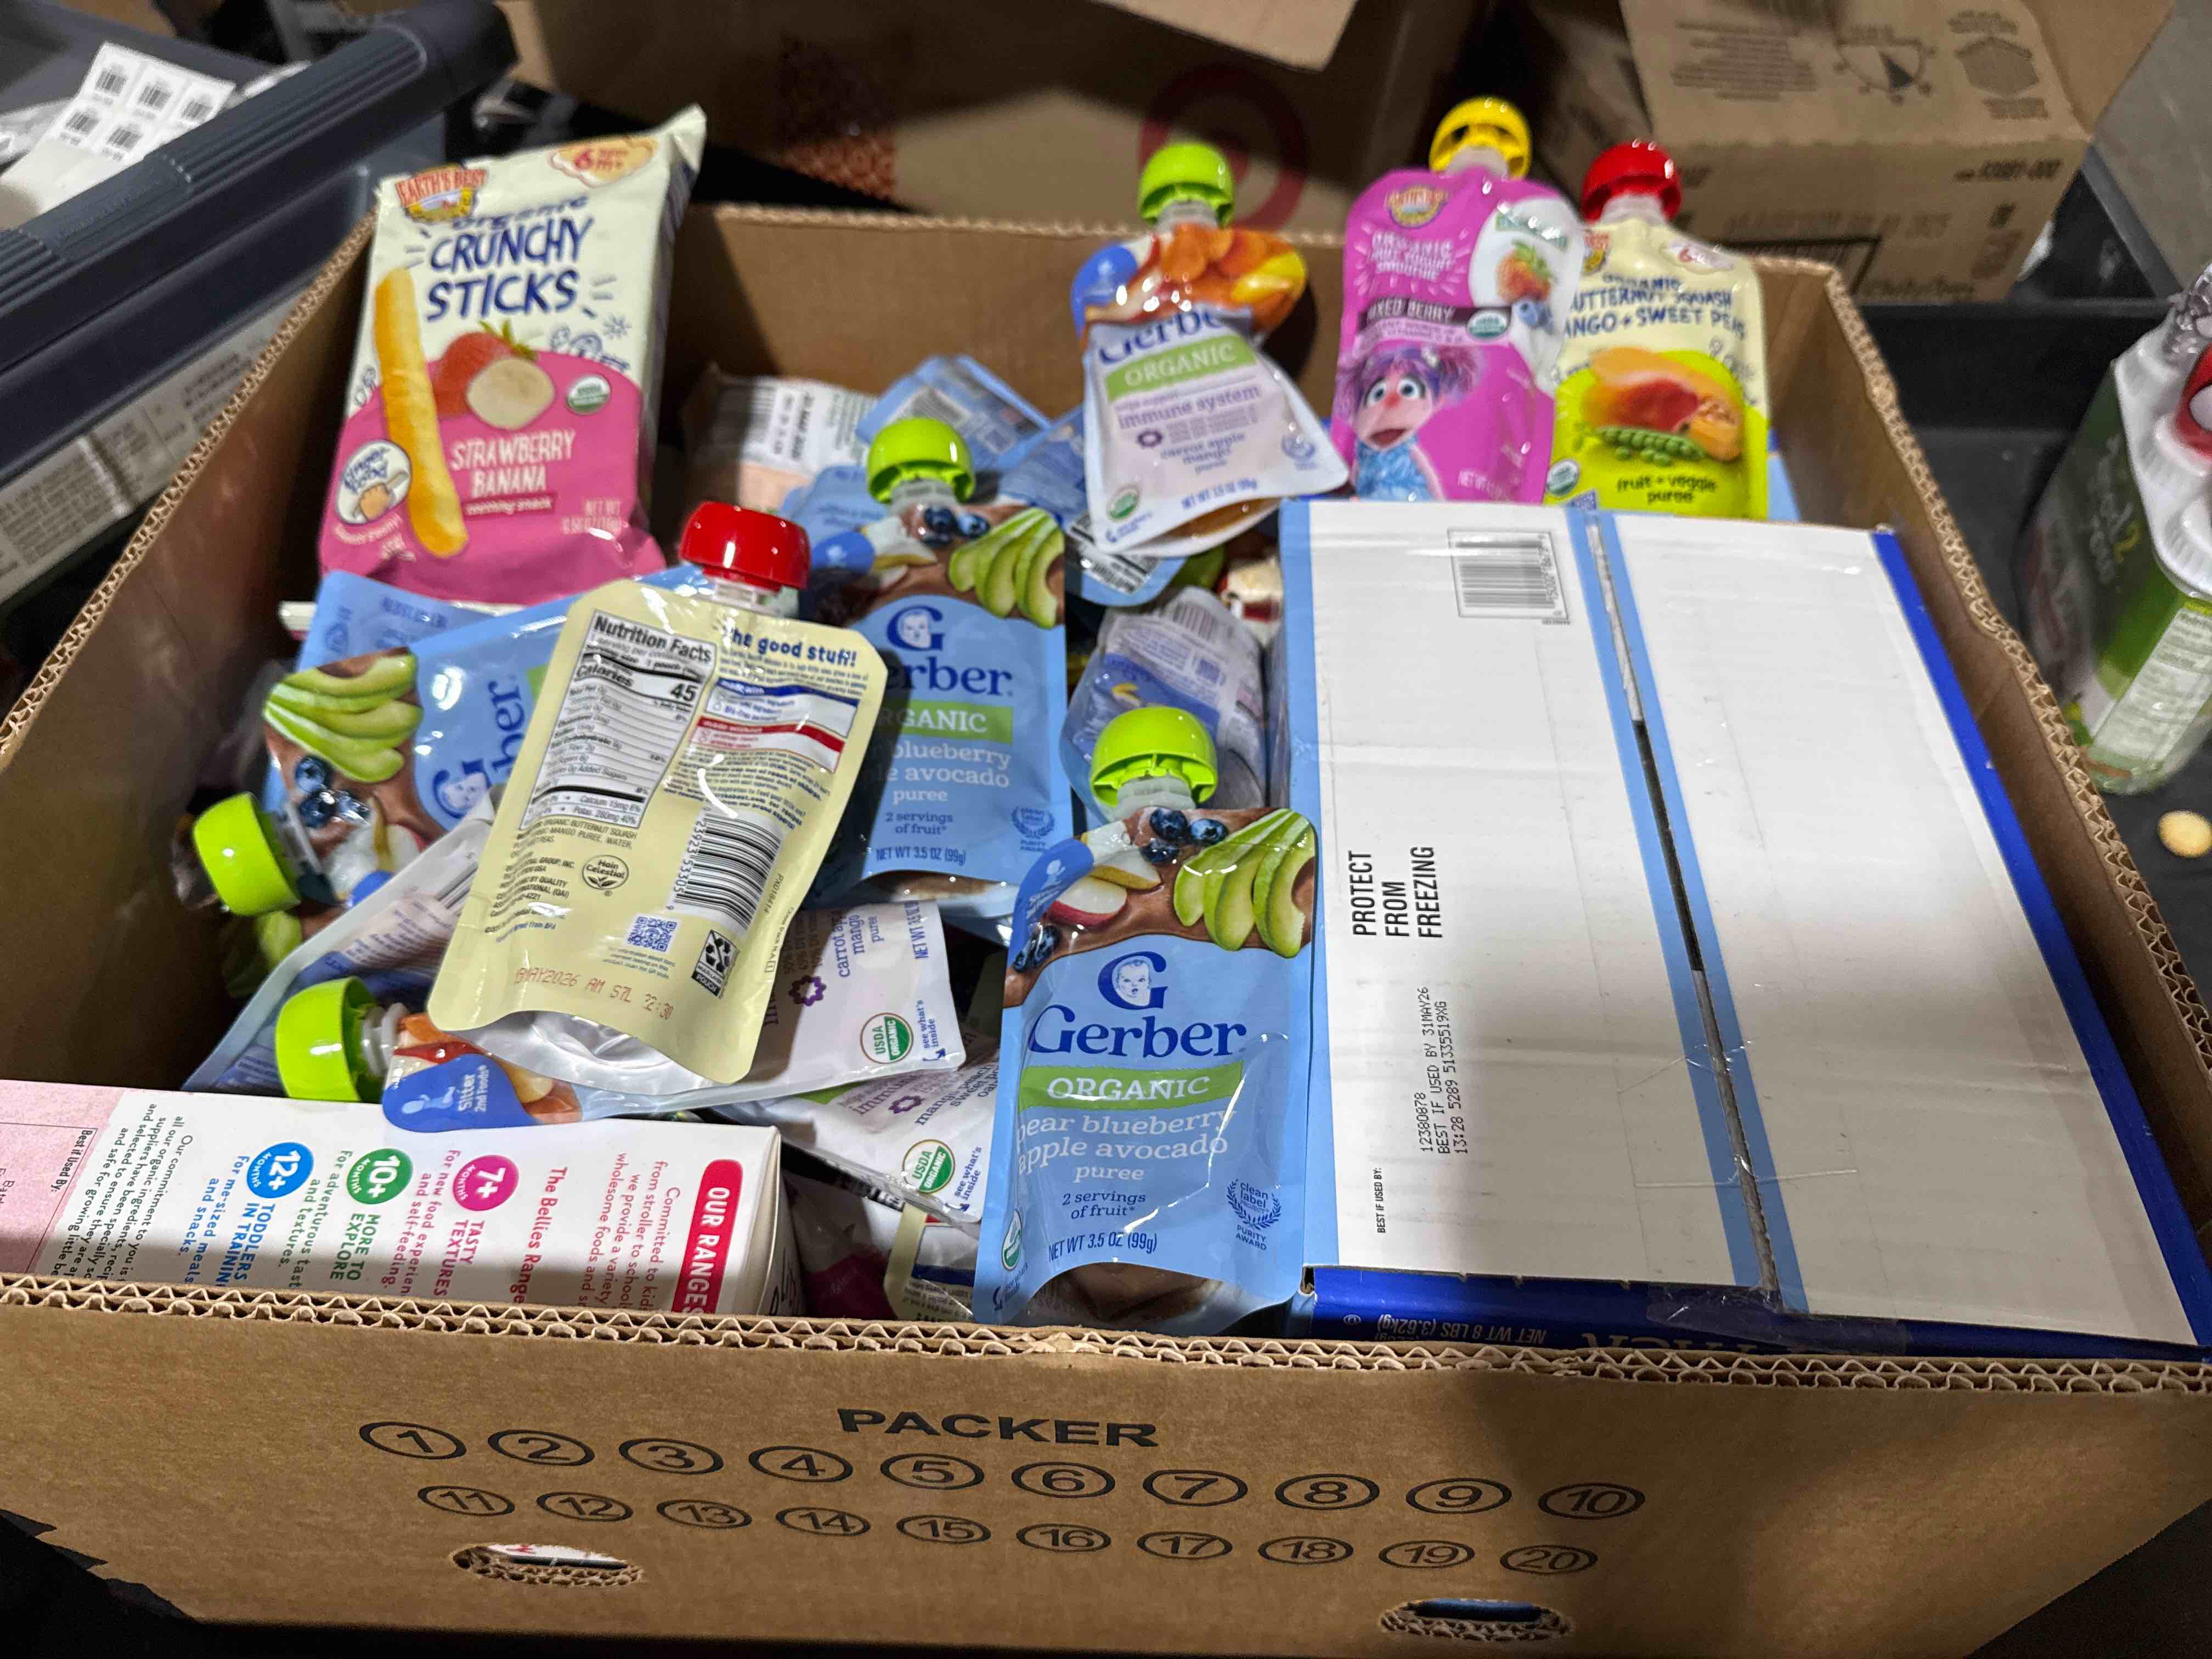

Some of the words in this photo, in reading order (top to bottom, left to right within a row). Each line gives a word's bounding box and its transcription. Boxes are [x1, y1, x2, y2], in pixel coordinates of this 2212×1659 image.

[430, 218, 594, 273] CRUNCHY
[426, 269, 579, 323] STICKS
[1564, 310, 1617, 338] ANGO
[1635, 305, 1702, 327] SWEET
[1124, 341, 1238, 386] ORGANIC
[1118, 402, 1193, 429] immune
[1195, 387, 1260, 411] system
[451, 431, 574, 470] STRAWBERRY
[472, 466, 546, 498] BANANA
[1647, 488, 1694, 505] puree
[595, 615, 667, 649] Nutrition
[670, 639, 712, 664] Facts
[758, 637, 803, 658] good
[807, 645, 857, 667] stuff!
[670, 684, 697, 702] 45
[904, 766, 1010, 788] avocado
[893, 789, 949, 806] puree
[896, 812, 953, 825] servings
[598, 859, 619, 870] Hain
[894, 847, 912, 859] WT
[585, 864, 625, 879] Celestial
[1348, 850, 1377, 935] PROTECT
[1410, 847, 1443, 939] FREEZING
[1381, 881, 1409, 937] FROM
[849, 914, 865, 955] mango
[868, 915, 884, 943] puree
[833, 933, 850, 978] carrot
[917, 1000, 929, 1034] what's
[1417, 987, 1435, 1036] 31MAY26
[872, 1025, 886, 1054] USDA
[887, 1019, 901, 1056] ORGANIC
[928, 1018, 939, 1047] inside
[1028, 1004, 1247, 1058] Gerber
[1424, 1043, 1437, 1057] BY
[458, 1074, 475, 1113] Sitter
[1047, 1076, 1210, 1101] ORGANIC
[1427, 1064, 1442, 1094] USED
[1444, 1080, 1462, 1109] 5289
[1082, 1109, 1238, 1137] blueberry
[1431, 1101, 1445, 1114] IF
[74, 1130, 93, 1148] Best
[121, 1124, 146, 1165] selected
[139, 1116, 167, 1159] suppliers
[175, 1135, 194, 1156] Our
[1434, 1123, 1451, 1154] BEST
[1450, 1116, 1468, 1154] 13:28
[59, 1156, 78, 1177] Used
[103, 1147, 118, 1168] safe
[141, 1149, 167, 1192] organic
[268, 1150, 301, 1192] 12+
[442, 1149, 461, 1167] For
[912, 1150, 932, 1180] USDA
[924, 1151, 948, 1189] ORGANIC
[962, 1146, 983, 1181] what's
[1018, 1136, 1088, 1176] apple
[1094, 1136, 1229, 1160] avocado
[131, 1163, 146, 1187] have
[201, 1177, 219, 1203] and
[367, 1155, 401, 1199] 10+
[416, 1172, 431, 1197] and
[433, 1171, 449, 1195] new
[545, 1166, 568, 1193] The
[599, 1153, 628, 1222] wholesome
[647, 1160, 669, 1192] from
[961, 1170, 982, 1201] inside
[1073, 1166, 1146, 1183] puree
[1240, 1181, 1268, 1200] clean
[97, 1181, 119, 1217] ensure
[119, 1189, 133, 1215] been
[145, 1158, 179, 1228] commitment
[303, 1179, 320, 1203] and
[701, 1187, 731, 1227] OUR
[1062, 1193, 1073, 1206] 2
[1074, 1192, 1147, 1204] servings
[1240, 1189, 1266, 1208] label
[1373, 1181, 1384, 1202] USED
[1375, 1203, 1385, 1211] IF
[67, 1188, 97, 1232] growing
[114, 1189, 151, 1251] ingredients,
[205, 1178, 236, 1237] me-sized
[302, 1172, 340, 1254] adventurous
[421, 1201, 442, 1229] food
[528, 1197, 559, 1249] Bellies
[614, 1194, 634, 1243] provide
[636, 1194, 655, 1240] stroller
[1071, 1205, 1087, 1219] of
[1376, 1212, 1386, 1233] BEST
[89, 1217, 116, 1265] specially
[178, 1205, 207, 1257] snacks.
[278, 1206, 314, 1268] textures.
[354, 1213, 381, 1255] MORE
[649, 1187, 681, 1263] Committed
[1237, 1224, 1267, 1243] PURITY
[58, 1234, 78, 1260] little
[233, 1202, 276, 1282] TODDLERS
[330, 1212, 365, 1280] EXPLORE
[381, 1200, 422, 1289] self-feeding.
[433, 1219, 469, 1297] TEXTURES
[459, 1220, 485, 1265] TASTY
[588, 1226, 611, 1262] foods
[1048, 1241, 1064, 1262] NET
[1066, 1235, 1084, 1252] WT
[1087, 1233, 1104, 1249] 3.5
[1108, 1232, 1124, 1248] OZ
[1127, 1232, 1159, 1255] (99g)
[1235, 1233, 1267, 1251] AWARD
[346, 1261, 365, 1281] TO
[509, 1253, 543, 1304] Range
[595, 1258, 619, 1306] variety
[1377, 1313, 1437, 1339] (3.62kg)
[1440, 1324, 1469, 1340] LBS
[1485, 1326, 1512, 1342] WT
[1517, 1328, 1549, 1344] NET
[837, 1407, 1160, 1448] PACKER
[397, 1430, 435, 1453] 1
[518, 1437, 571, 1461] 2
[647, 1445, 695, 1469] 3
[781, 1454, 825, 1476] 4
[912, 1461, 956, 1484] 5
[1041, 1469, 1086, 1492] 6
[1174, 1475, 1219, 1501] 7
[1303, 1481, 1348, 1505] 8
[1436, 1485, 1482, 1509] 9
[1566, 1490, 1626, 1513] 10
[440, 1490, 495, 1511] 11
[559, 1497, 620, 1518] 12
[678, 1504, 733, 1525] 13
[799, 1511, 856, 1533] 14
[918, 1519, 976, 1541] 15
[1039, 1528, 1094, 1549] 16
[1160, 1536, 1216, 1555] 17
[1283, 1541, 1337, 1560] 18
[1404, 1545, 1459, 1564] 19
[1521, 1550, 1578, 1570] 20
